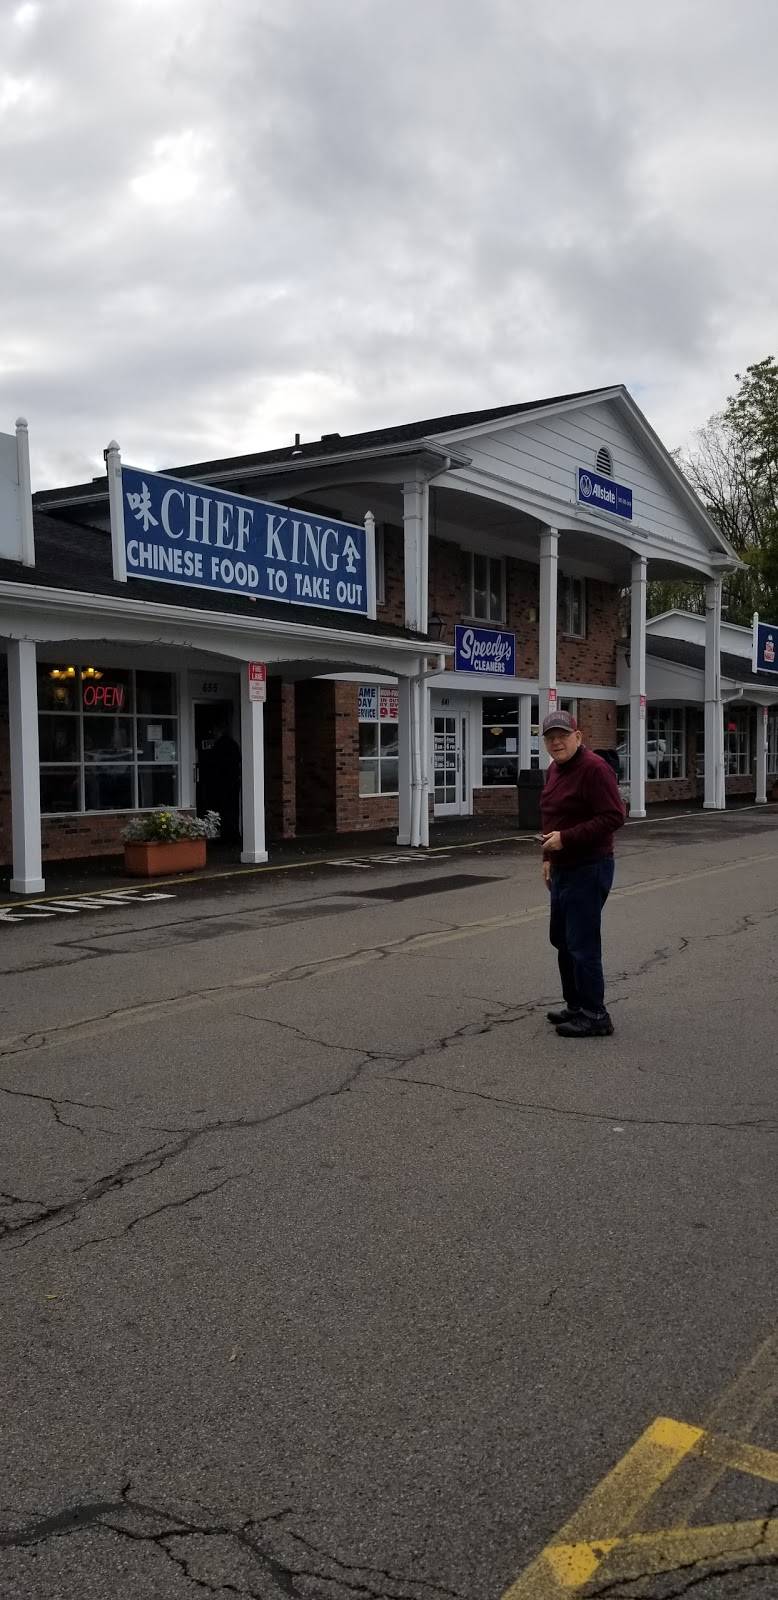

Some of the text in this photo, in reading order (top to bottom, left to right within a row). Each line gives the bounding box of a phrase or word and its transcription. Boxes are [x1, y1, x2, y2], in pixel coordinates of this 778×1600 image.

[592, 483, 616, 504] Allstate
[126, 481, 159, 532] 味
[161, 489, 339, 572] CHEF KING
[126, 539, 362, 605] CHINESE FOOD TO TAKE OUT
[459, 629, 512, 665] Speedy's
[473, 659, 506, 673] CLEANERS
[84, 686, 124, 706] OPEN
[358, 687, 376, 698] AME
[358, 698, 372, 708] DAY
[358, 708, 376, 719] ERVICE
